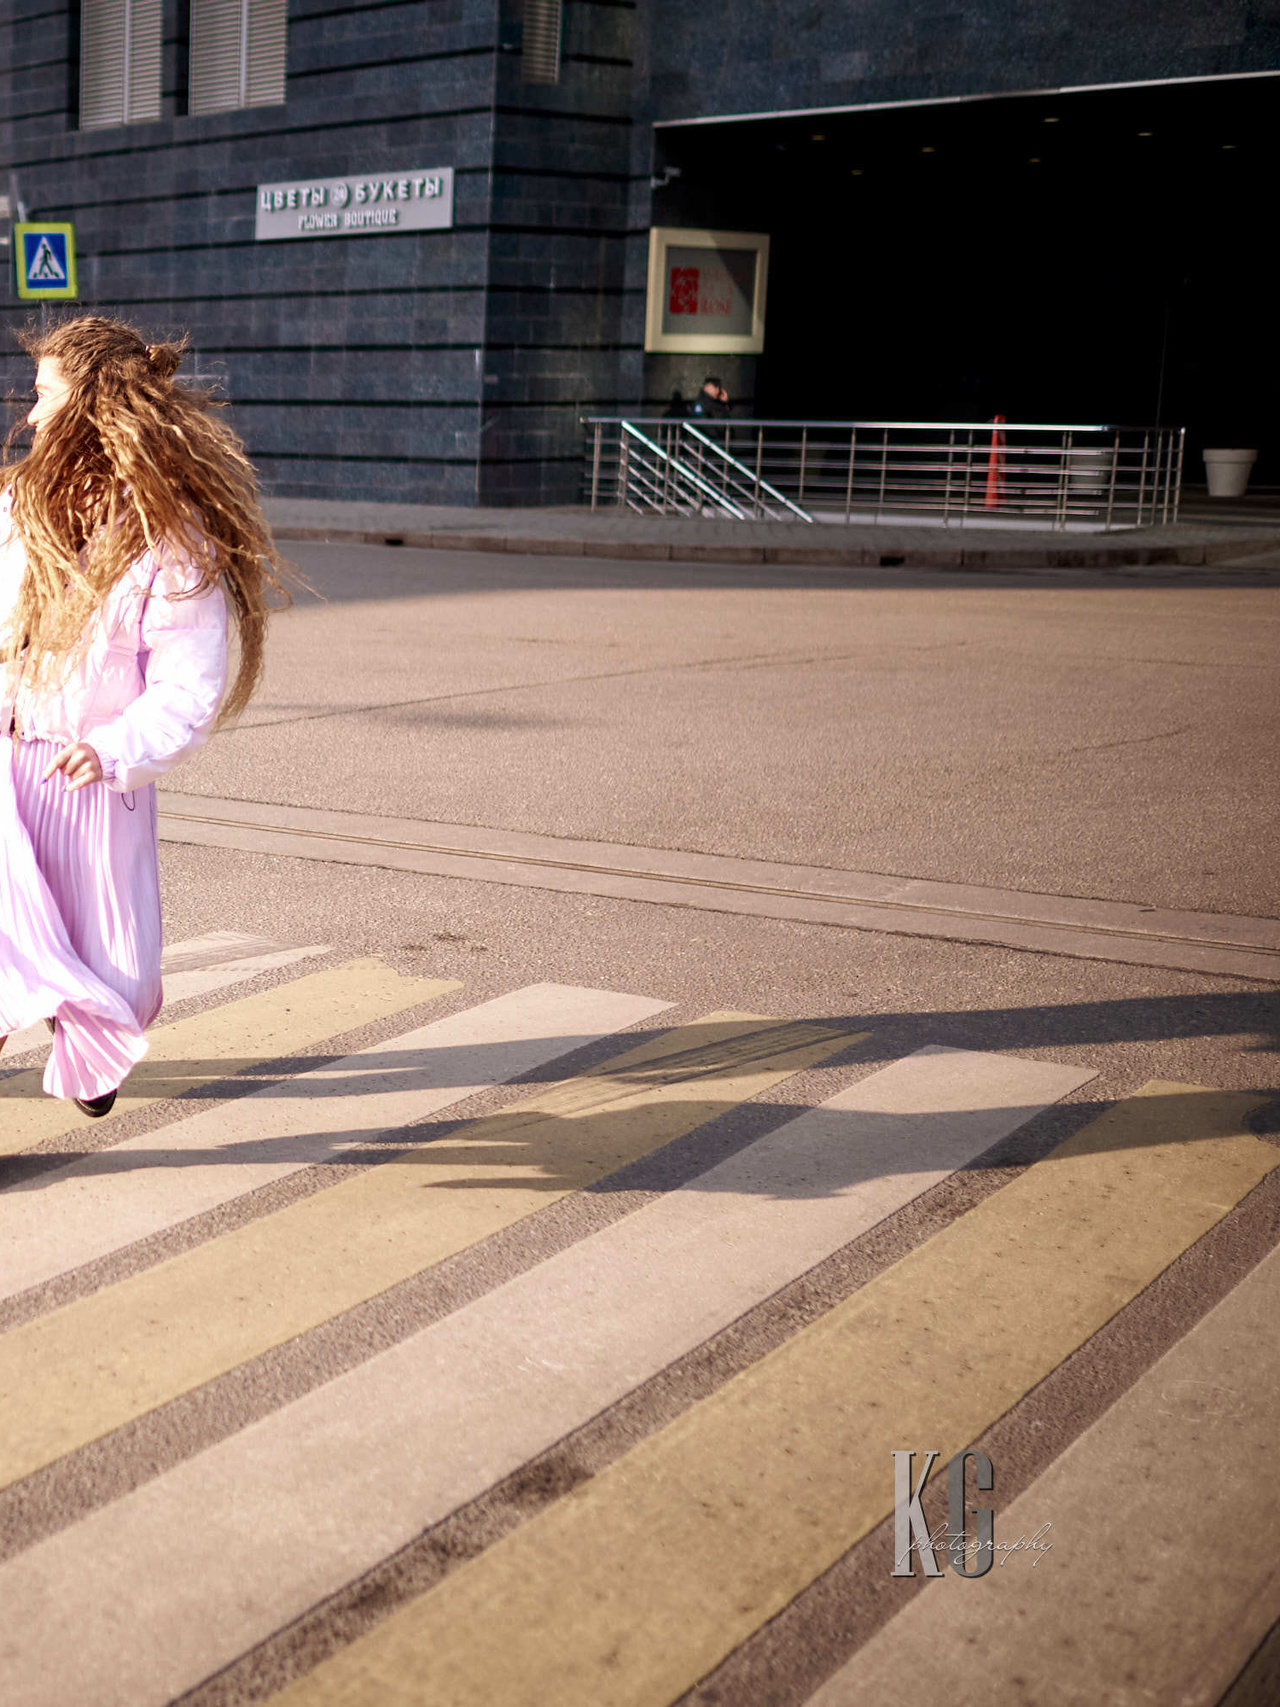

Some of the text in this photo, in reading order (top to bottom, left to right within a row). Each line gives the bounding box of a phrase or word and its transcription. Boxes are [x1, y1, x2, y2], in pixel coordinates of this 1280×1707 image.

[261, 177, 441, 210] ЦВЕТЫ БУКЕТЫ
[298, 208, 398, 230] FLOWER BOUTIQUE
